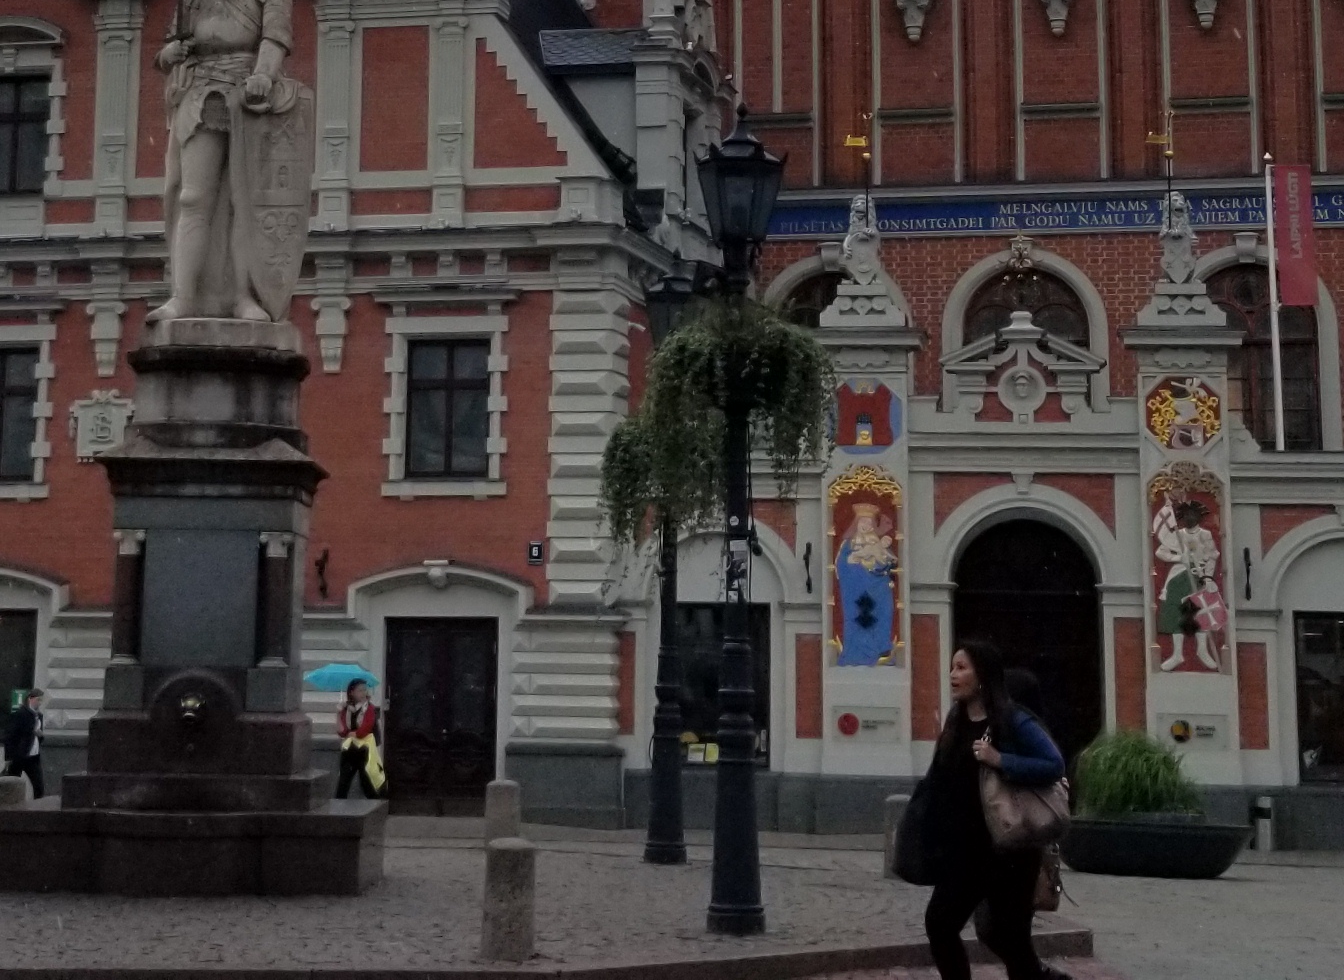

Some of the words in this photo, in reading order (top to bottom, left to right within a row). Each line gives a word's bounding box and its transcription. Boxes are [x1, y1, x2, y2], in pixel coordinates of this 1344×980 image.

[1105, 200, 1148, 212] NAMS
[877, 217, 984, 231] ONSIMTGADEI
[991, 216, 1017, 228] PAR
[1025, 215, 1070, 227] GODU
[1078, 214, 1126, 226] NAMU
[1134, 212, 1156, 225] UZ
[1289, 214, 1303, 259] LAIPNI
[532, 546, 538, 556] 6
